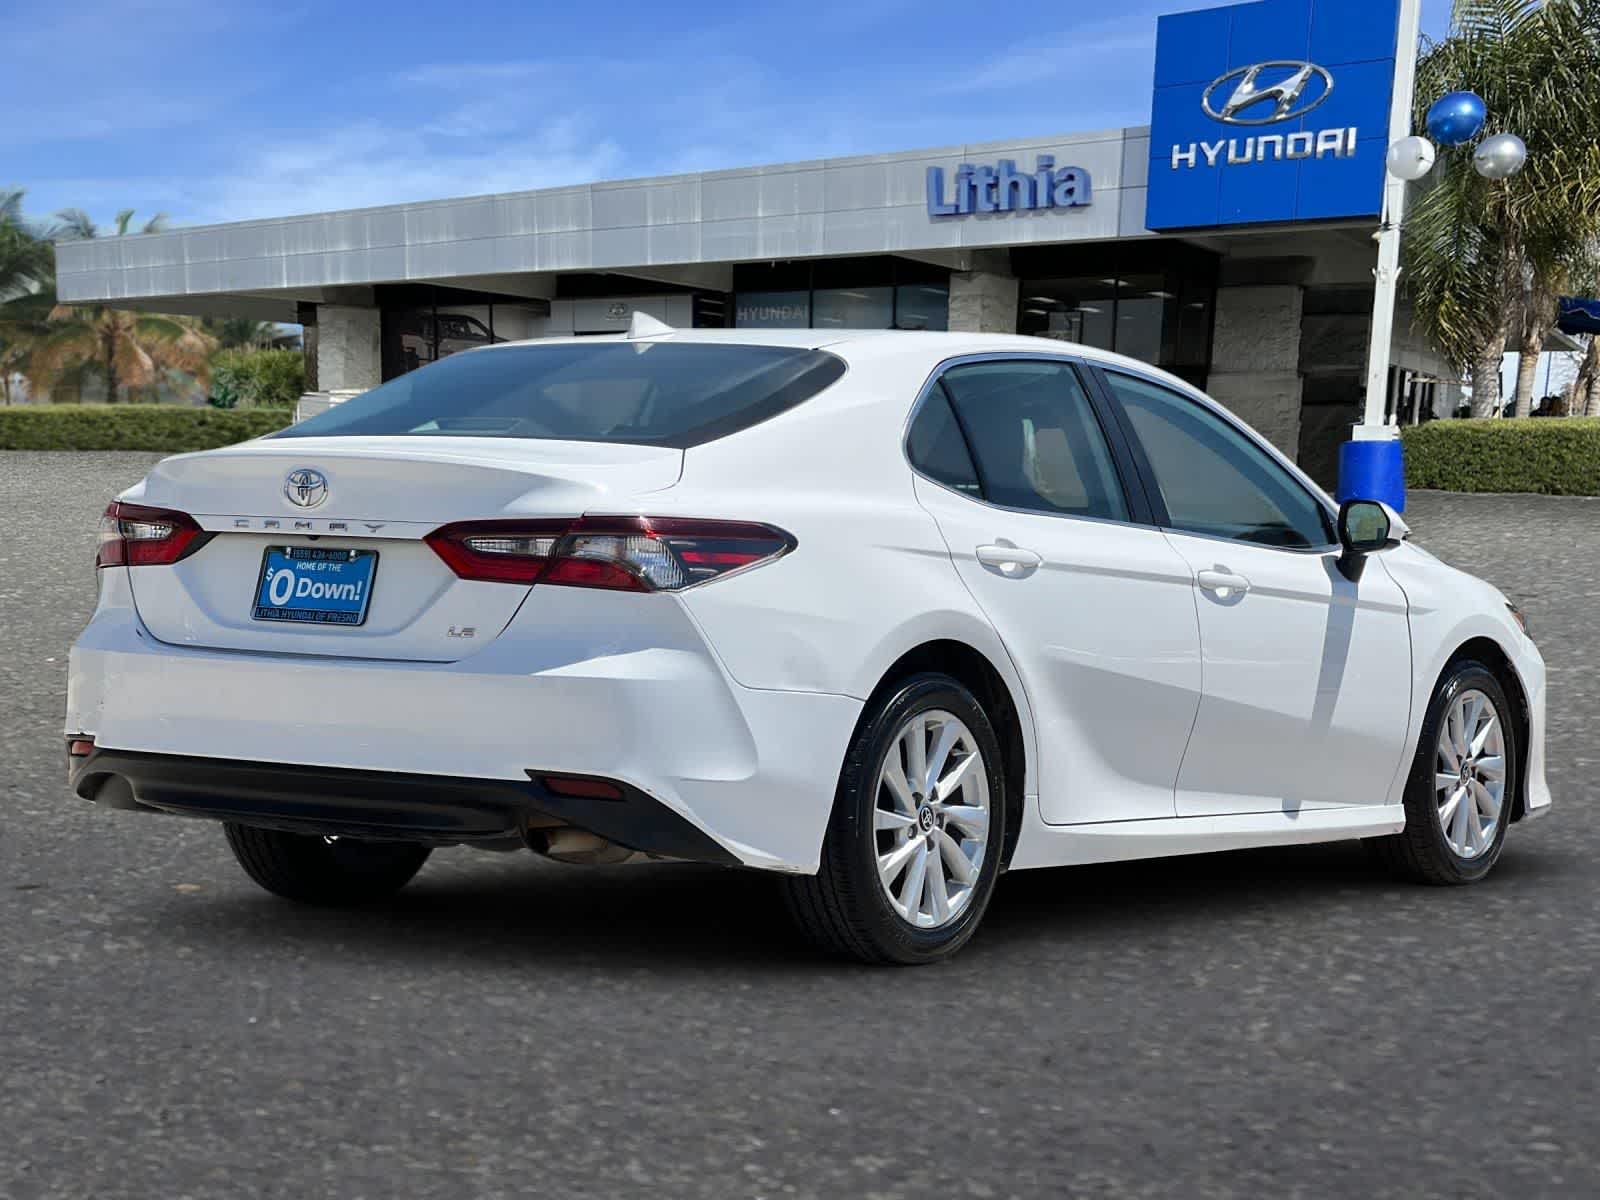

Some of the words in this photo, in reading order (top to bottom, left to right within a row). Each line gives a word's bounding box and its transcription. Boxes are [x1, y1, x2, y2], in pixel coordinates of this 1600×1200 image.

[1171, 127, 1358, 169] HYUNDAI
[926, 155, 1093, 217] Lithia
[737, 306, 809, 321] HYUNDAI
[234, 519, 385, 533] CAMRY
[296, 562, 316, 571] HOME
[317, 563, 327, 571] OF
[328, 564, 342, 572] THE
[295, 578, 362, 600] Down!
